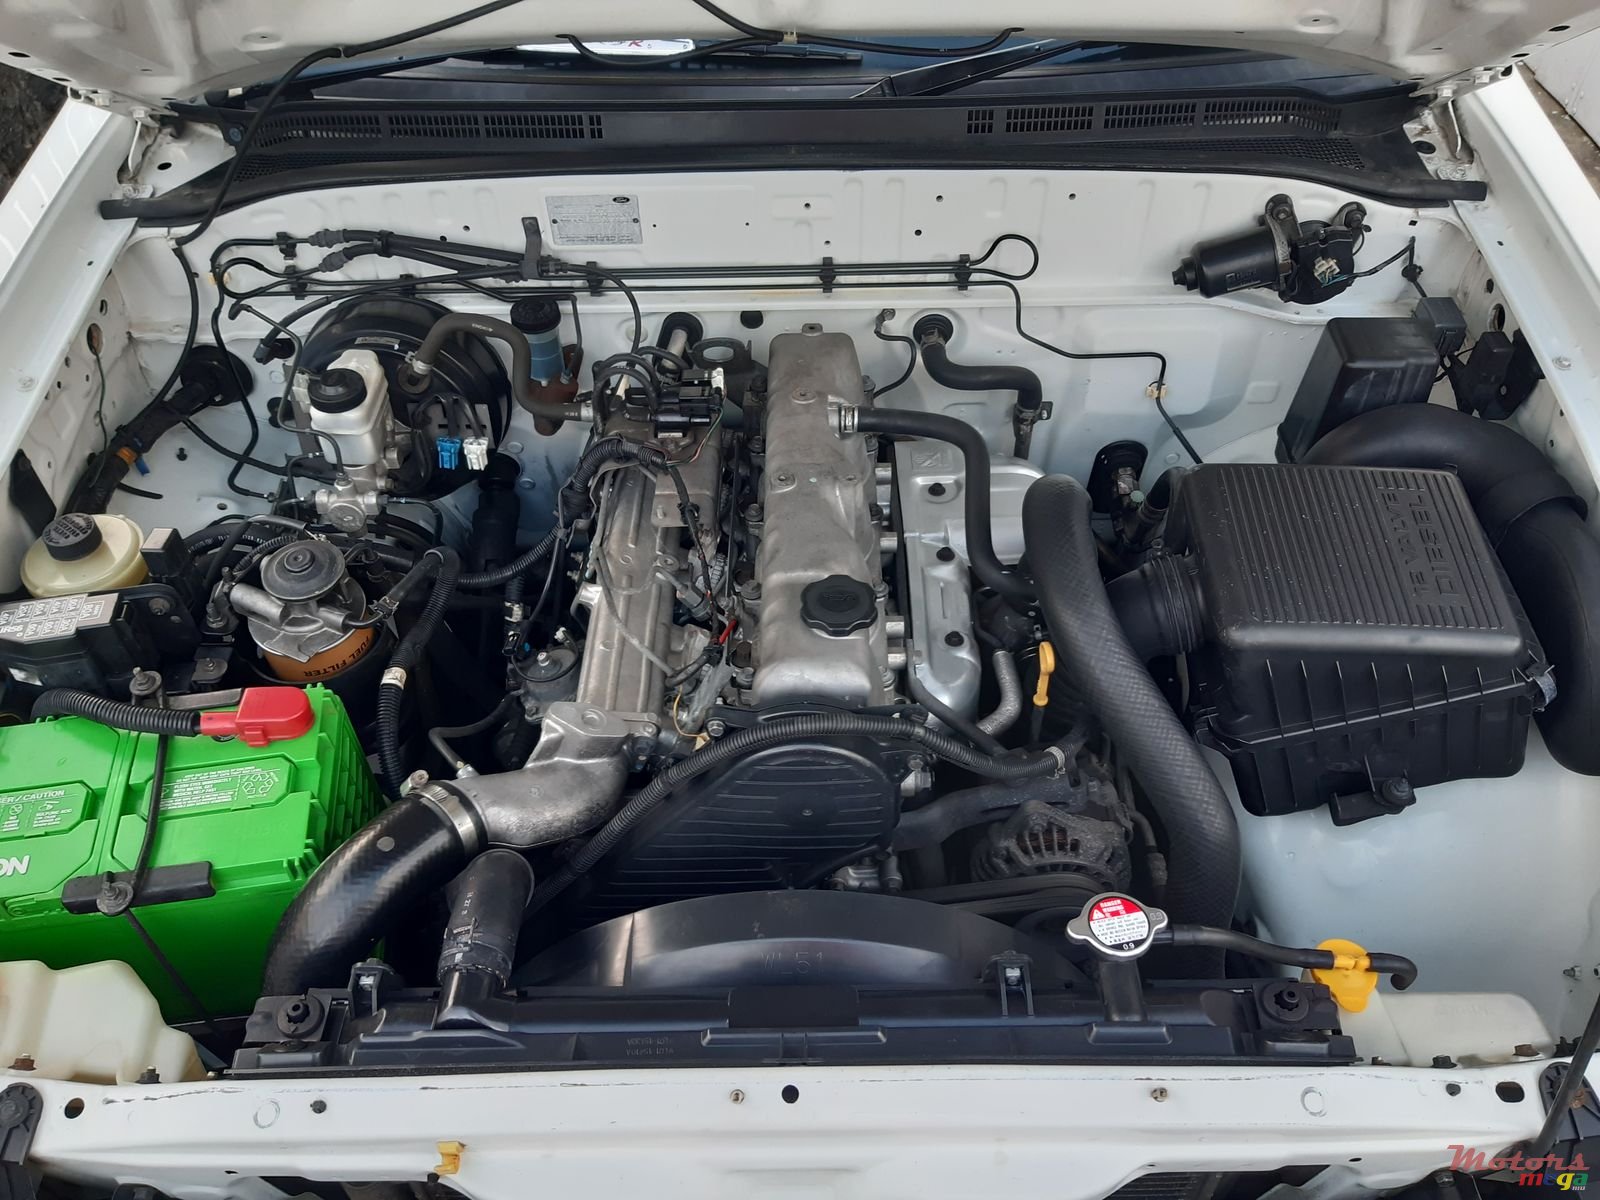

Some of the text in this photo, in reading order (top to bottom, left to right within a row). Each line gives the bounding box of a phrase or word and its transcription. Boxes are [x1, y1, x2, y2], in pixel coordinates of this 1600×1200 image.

[1382, 493, 1418, 565] VALVE
[1409, 495, 1460, 596] DIESEL
[303, 636, 369, 677] FUEL FILTER
[23, 790, 65, 800] CAUTION
